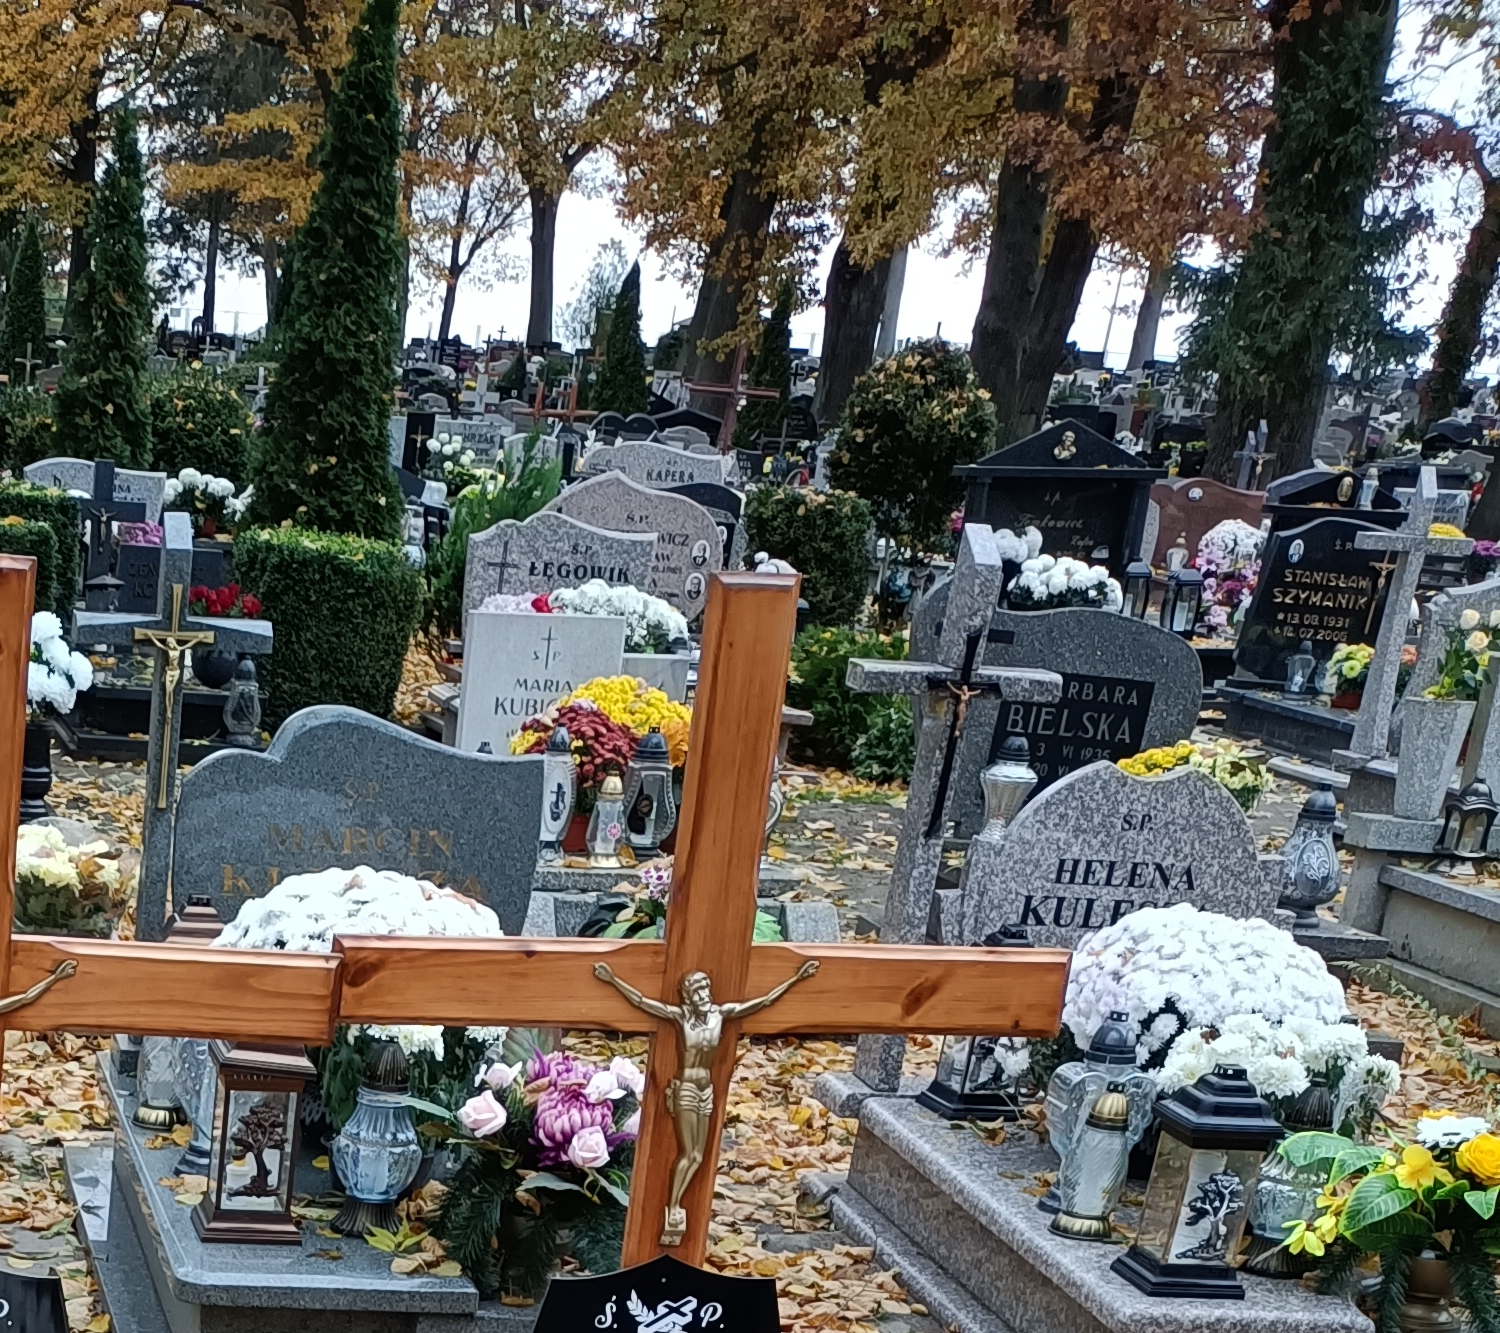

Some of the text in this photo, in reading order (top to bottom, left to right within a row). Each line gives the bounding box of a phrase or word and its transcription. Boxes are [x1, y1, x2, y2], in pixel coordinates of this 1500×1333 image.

[646, 469, 695, 484] KAPERA
[528, 561, 630, 584] ŁĘGOWIK
[1283, 568, 1370, 590] STANISŁAW
[1272, 587, 1368, 611] SZYMANIK
[513, 678, 574, 693] MARIA
[1067, 681, 1138, 706] RBARA
[1006, 703, 1131, 744] BIELSKA
[266, 823, 454, 858] MARCIN
[1054, 858, 1196, 891] HELENA
[1018, 894, 1207, 930] KULE
